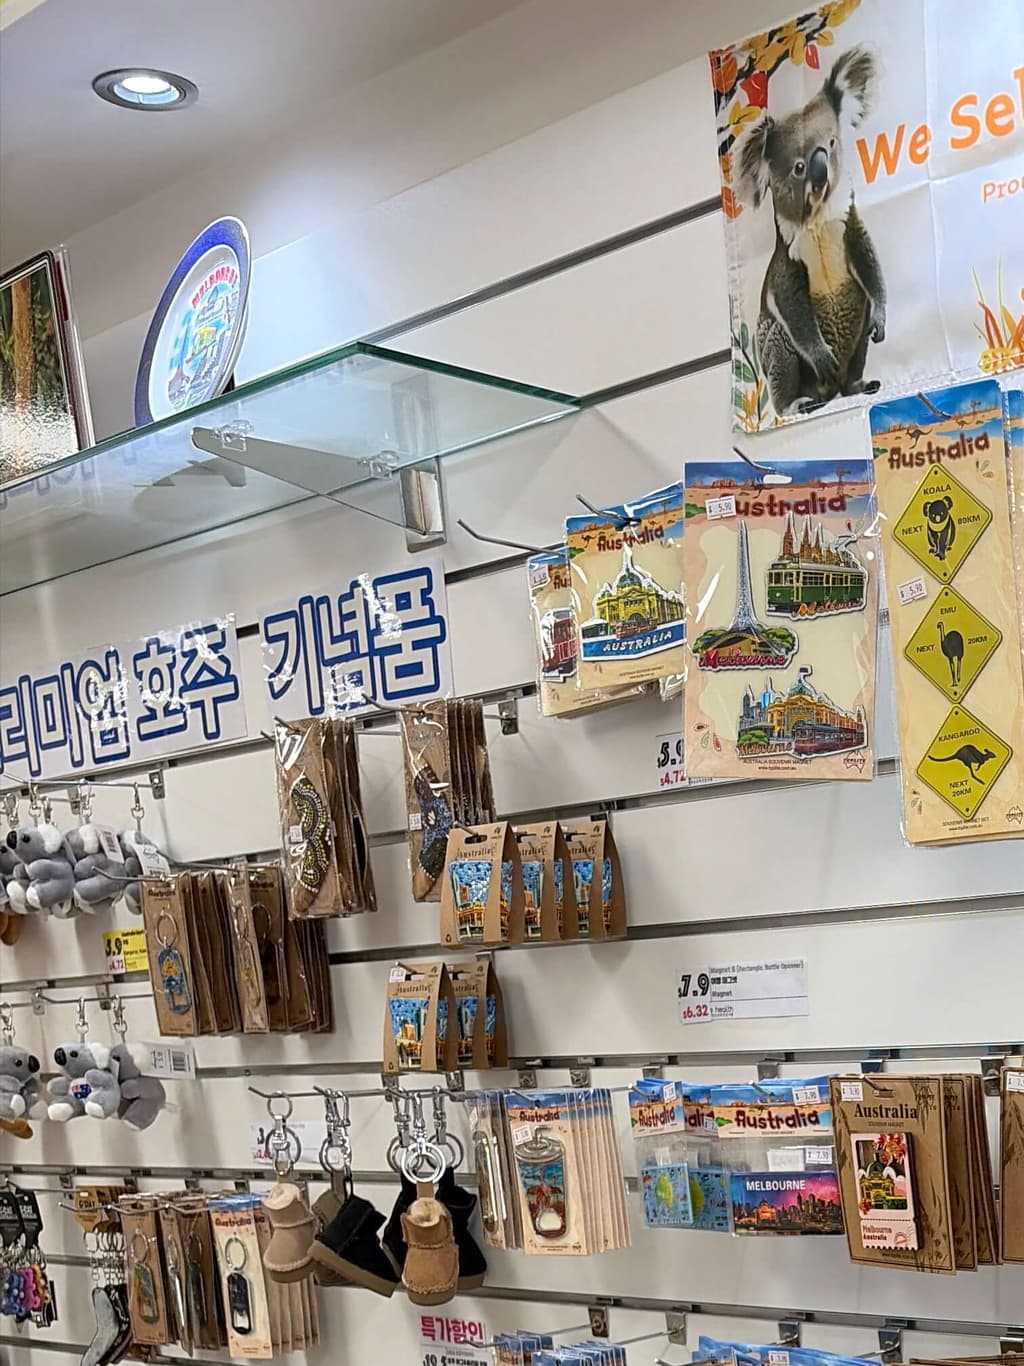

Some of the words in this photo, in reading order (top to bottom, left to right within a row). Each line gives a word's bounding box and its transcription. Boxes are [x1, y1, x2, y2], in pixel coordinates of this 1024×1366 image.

[856, 123, 932, 184] We
[888, 432, 990, 469] Australia
[923, 484, 952, 496] KOALA
[731, 493, 847, 517] ustralia
[901, 524, 923, 536] NEXT
[940, 606, 956, 616] EMU
[603, 631, 673, 652] AUSTRALIA
[916, 644, 935, 653] NEXT
[0, 645, 130, 778] 리미엄
[133, 622, 239, 741] 호주
[264, 567, 446, 716] 기념품
[938, 727, 981, 743] KANGAROO
[949, 779, 968, 789] NEXT
[683, 1004, 709, 1019] $6.32
[638, 1107, 675, 1127] Australia
[854, 1103, 918, 1120] Australia
[735, 1110, 820, 1130] Australia
[746, 1180, 806, 1191] MELBOURNE
[862, 1225, 893, 1234] Melbourne
[421, 1316, 483, 1345] 특가할인
